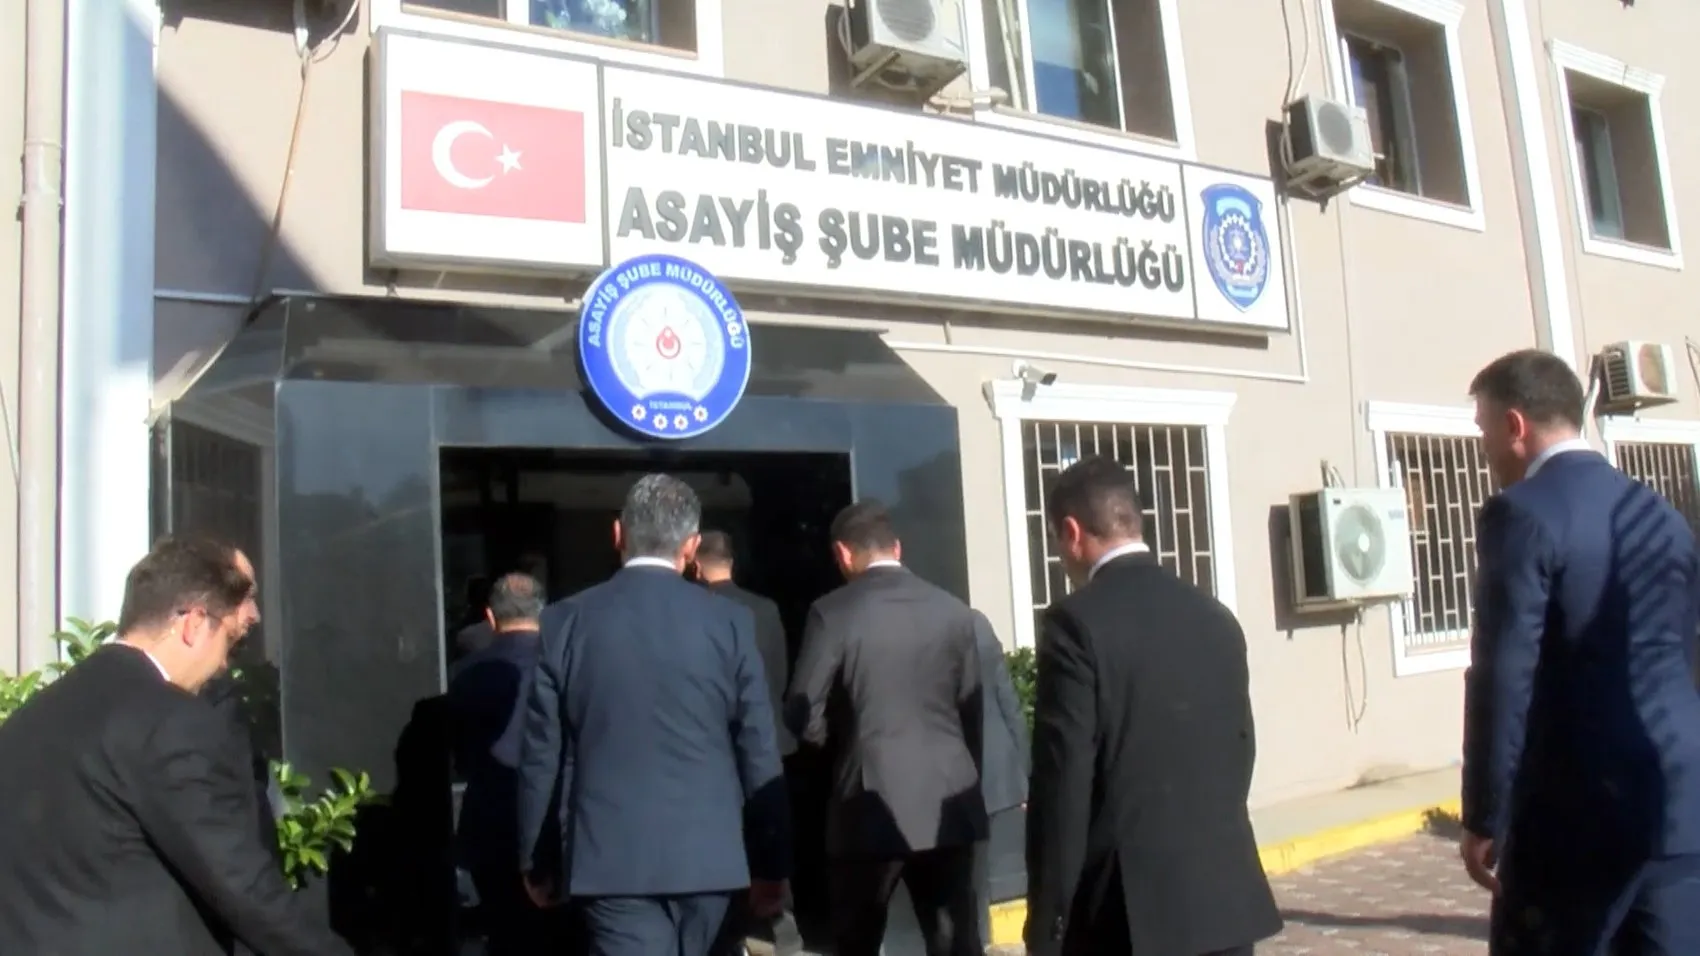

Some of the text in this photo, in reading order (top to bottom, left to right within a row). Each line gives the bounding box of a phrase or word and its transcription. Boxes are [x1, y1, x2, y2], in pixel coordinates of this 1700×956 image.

[612, 97, 1175, 223] İSTANBUL EMNİYET MÜDÜRLÜĞÜ
[616, 186, 1184, 292] ASAYİŞ ŞUBE MÜDÜRLÜĞÜ
[588, 262, 745, 348] ASAYİŞ ŞUBE MÜDÜRLÜĞÜ
